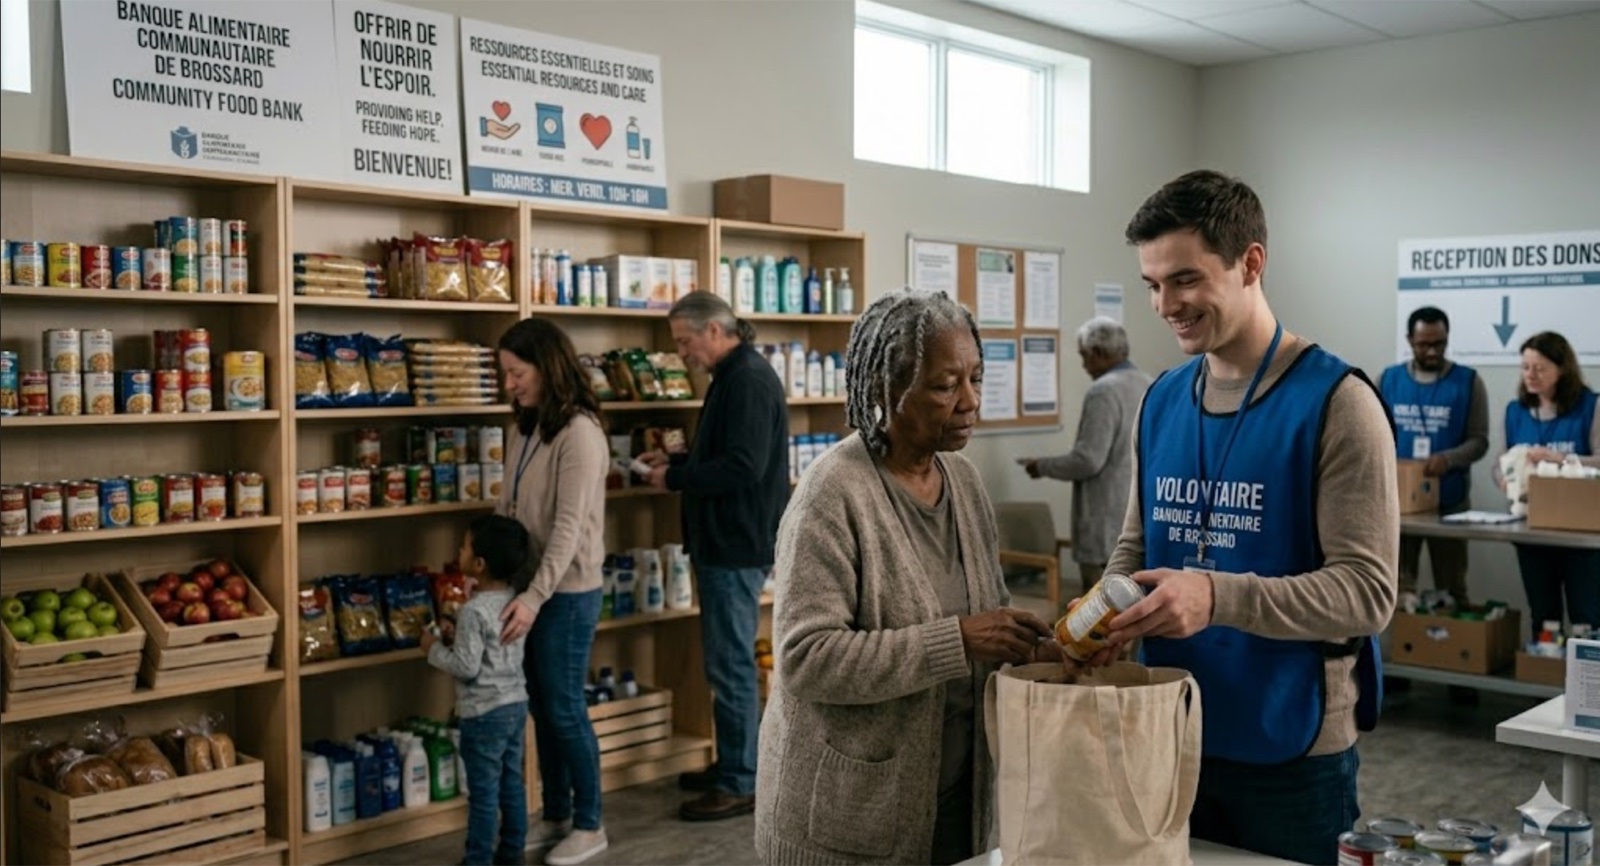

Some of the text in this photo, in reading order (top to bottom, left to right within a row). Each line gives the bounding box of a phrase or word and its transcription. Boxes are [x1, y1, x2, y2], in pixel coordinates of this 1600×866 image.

[117, 0, 290, 48] BANQUE ALIMENTAIRE
[354, 10, 437, 46] OFFRIR DE
[137, 27, 276, 68] COMMUNAUTAIRE
[360, 38, 433, 71] NOURRIR
[470, 36, 654, 84] RESSOURCES ESSENTIELLES ET SOINS
[155, 54, 263, 89] DE BROSSARD
[360, 65, 436, 98] L'ESPOIR.
[481, 60, 647, 103] ESSENTIAL RESOURCES AND CARE
[113, 78, 303, 122] COMMUNITY FOOD BANK
[355, 99, 413, 122] PROVIDING
[362, 119, 407, 139] FEEDING
[353, 148, 452, 181] BIENVENUE!
[1411, 242, 1600, 271] RECEPTION DES DONS
[1152, 506, 1262, 533] BANQUE AMENTAIRE
[1168, 526, 1236, 549] DE BRSSARD
